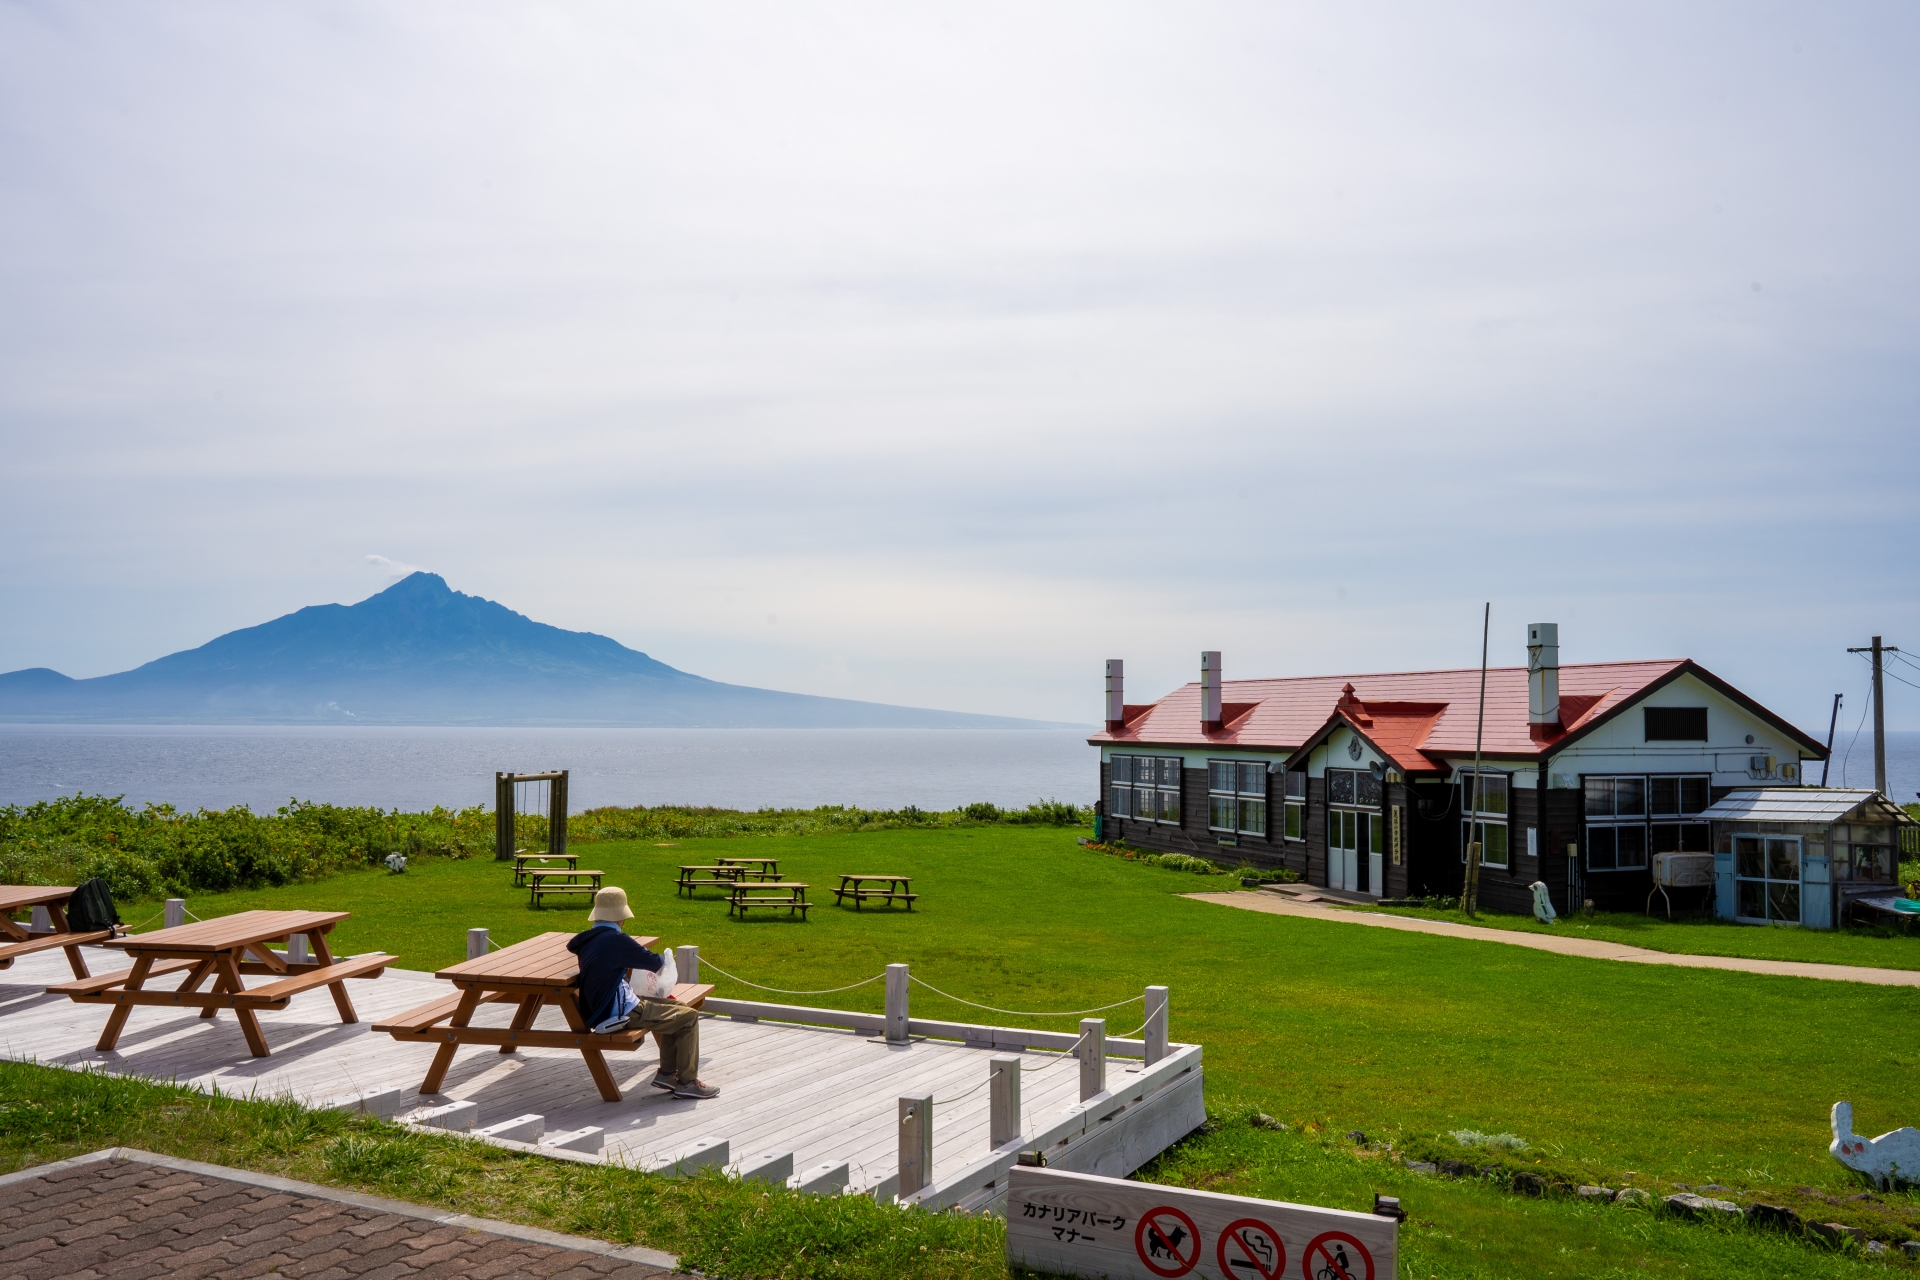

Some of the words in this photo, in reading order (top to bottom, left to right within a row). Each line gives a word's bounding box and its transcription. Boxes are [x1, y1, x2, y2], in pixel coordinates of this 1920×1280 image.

[1023, 1202, 1126, 1231] カナリアパーク
[1052, 1226, 1095, 1243] マナー
